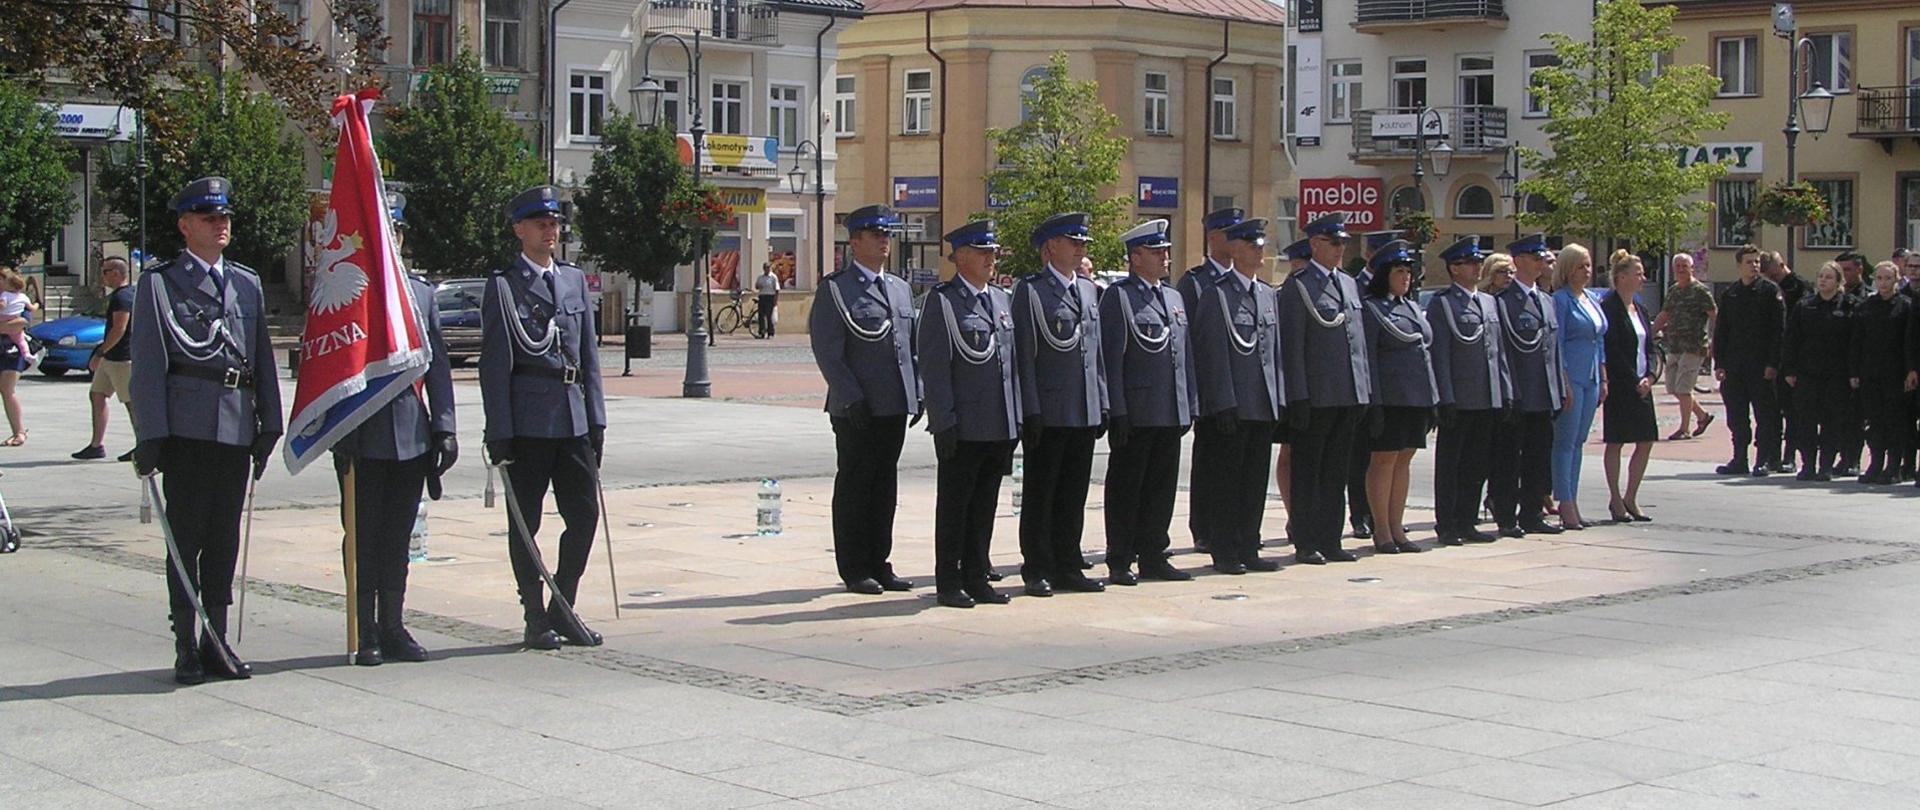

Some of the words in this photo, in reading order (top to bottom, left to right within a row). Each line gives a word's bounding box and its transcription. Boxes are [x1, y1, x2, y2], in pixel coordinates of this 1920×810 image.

[1300, 105, 1317, 117] 4F
[701, 140, 754, 154] Lokomotywa
[1303, 182, 1378, 206] meble
[1306, 210, 1374, 225] BZIO
